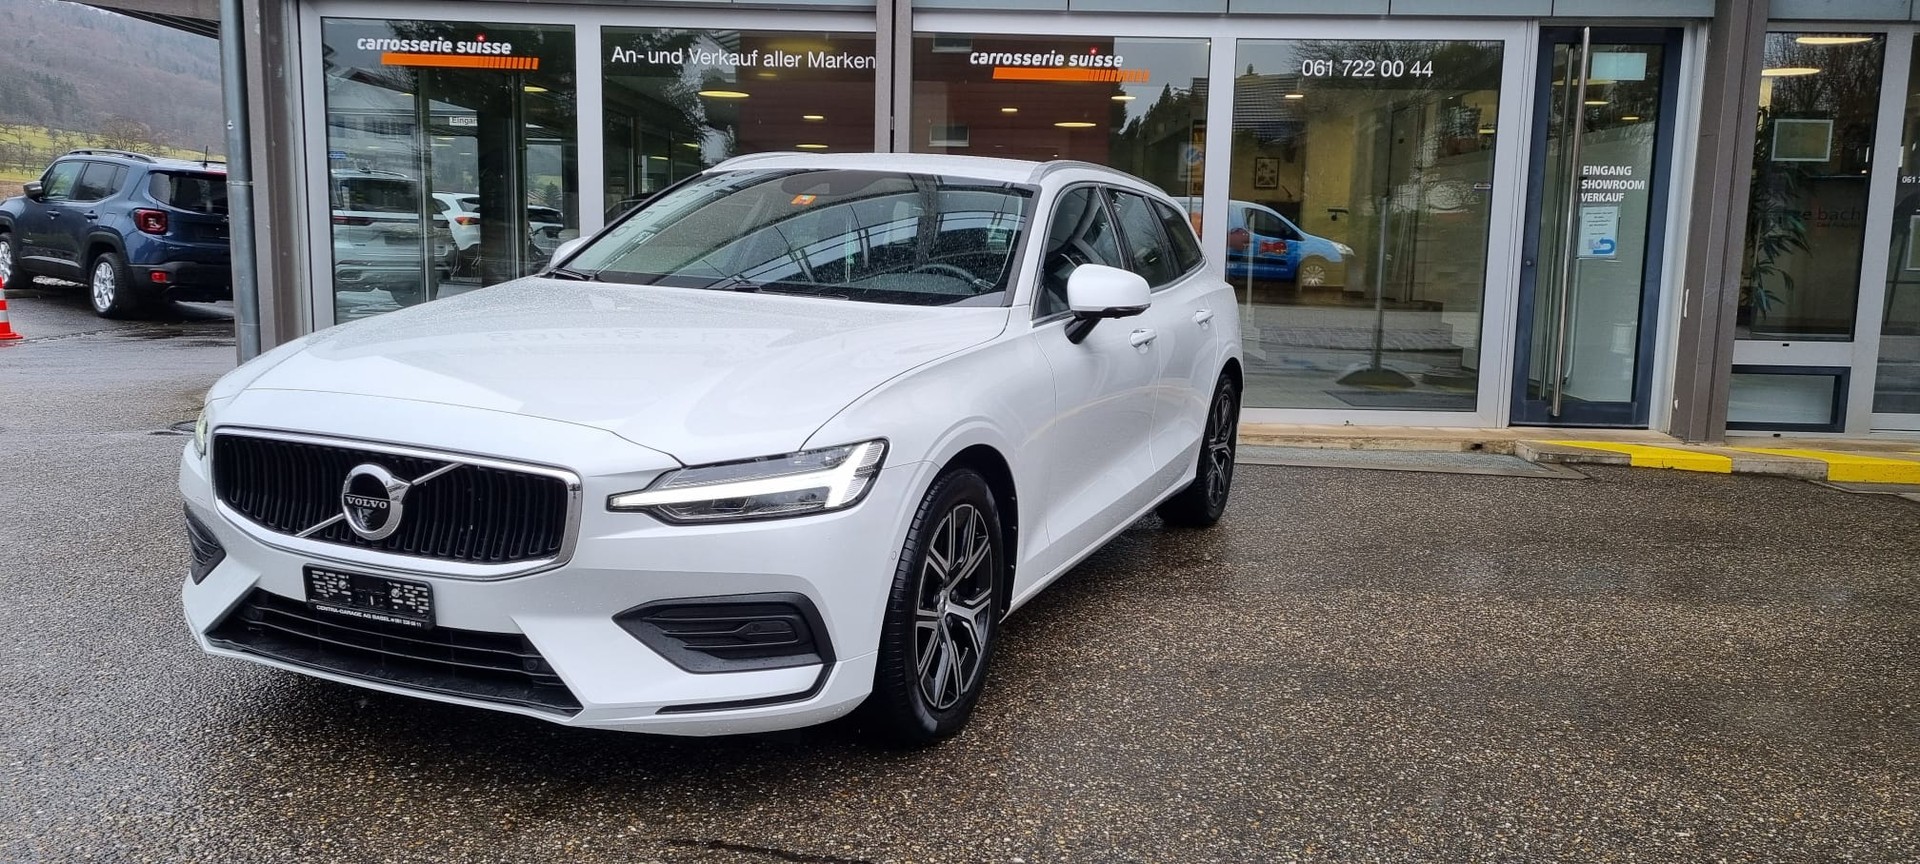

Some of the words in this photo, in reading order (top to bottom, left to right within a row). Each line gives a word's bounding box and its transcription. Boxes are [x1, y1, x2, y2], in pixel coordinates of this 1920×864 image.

[356, 36, 452, 53] carrosserie
[456, 34, 512, 54] suisse
[611, 46, 644, 64] An-
[648, 48, 683, 65] und
[688, 48, 758, 67] Verkauf
[763, 50, 802, 68] aller
[807, 51, 876, 69] Marken
[969, 50, 1064, 66] carrosserie
[1068, 48, 1124, 67] suisse
[1301, 59, 1333, 77] 061
[1341, 59, 1376, 77] 722
[1380, 59, 1405, 77] 00
[1409, 60, 1434, 78] 44
[1582, 165, 1632, 176] EINGANG
[1581, 179, 1646, 190] SHOWROOM
[1581, 192, 1625, 202] VERKAUF
[345, 496, 388, 509] VOLVO
